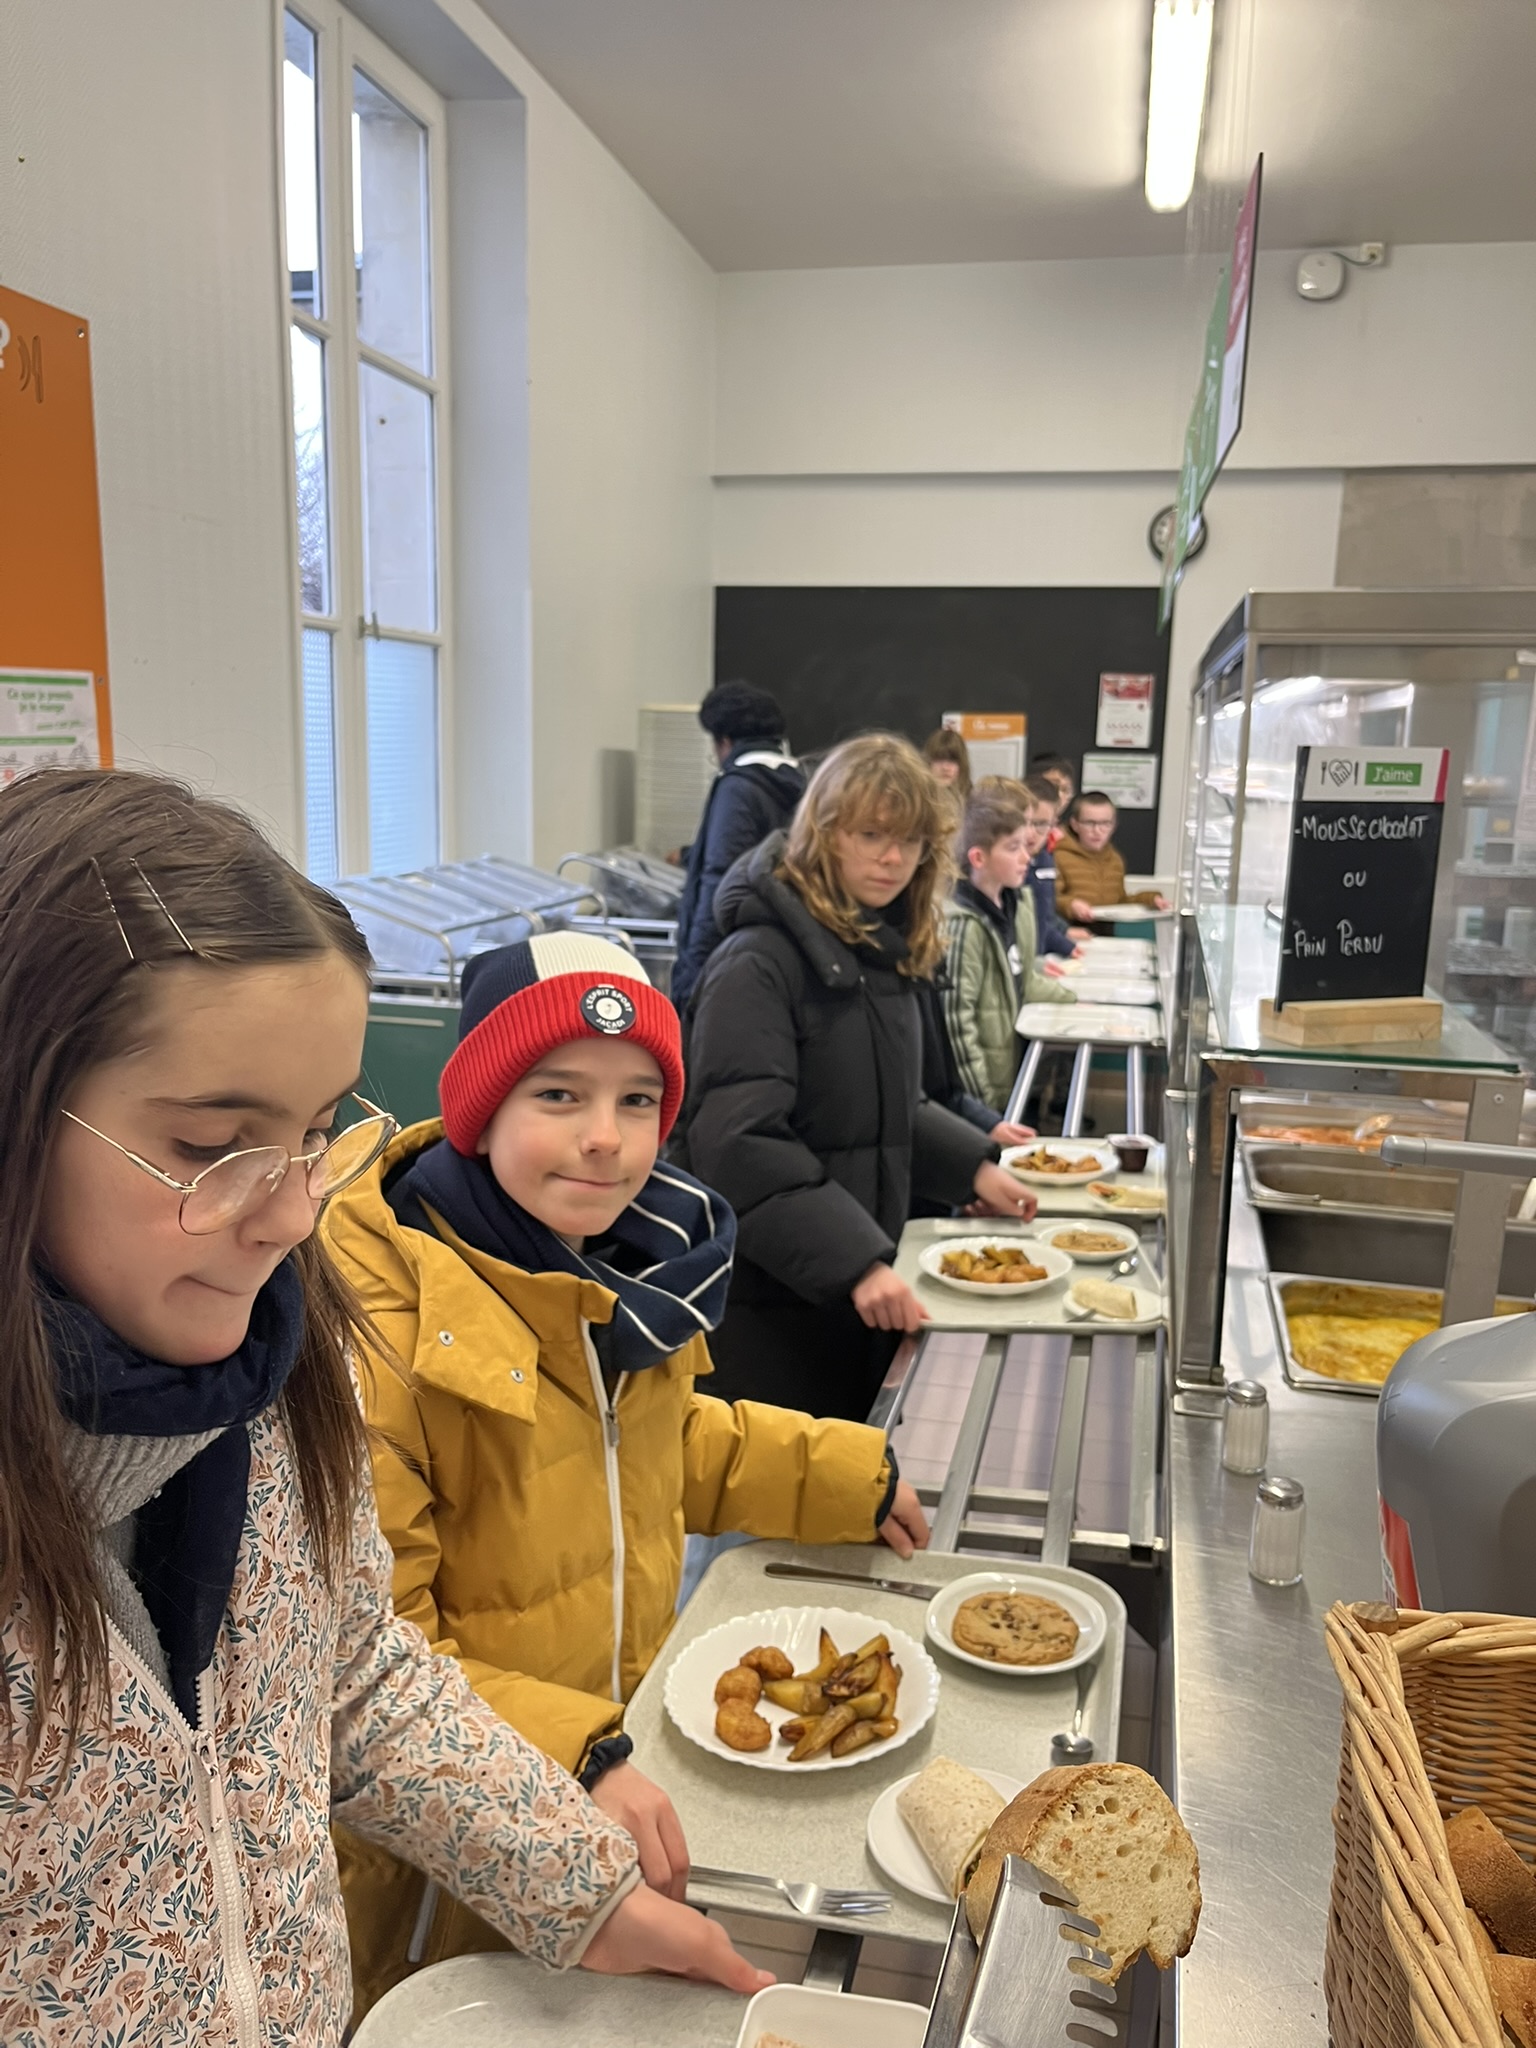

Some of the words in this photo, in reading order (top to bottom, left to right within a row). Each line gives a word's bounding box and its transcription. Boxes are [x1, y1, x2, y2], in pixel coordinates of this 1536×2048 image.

[1373, 766, 1414, 783] J'aime
[611, 989, 633, 1012] SPORT
[596, 1017, 626, 1030] JACADI
